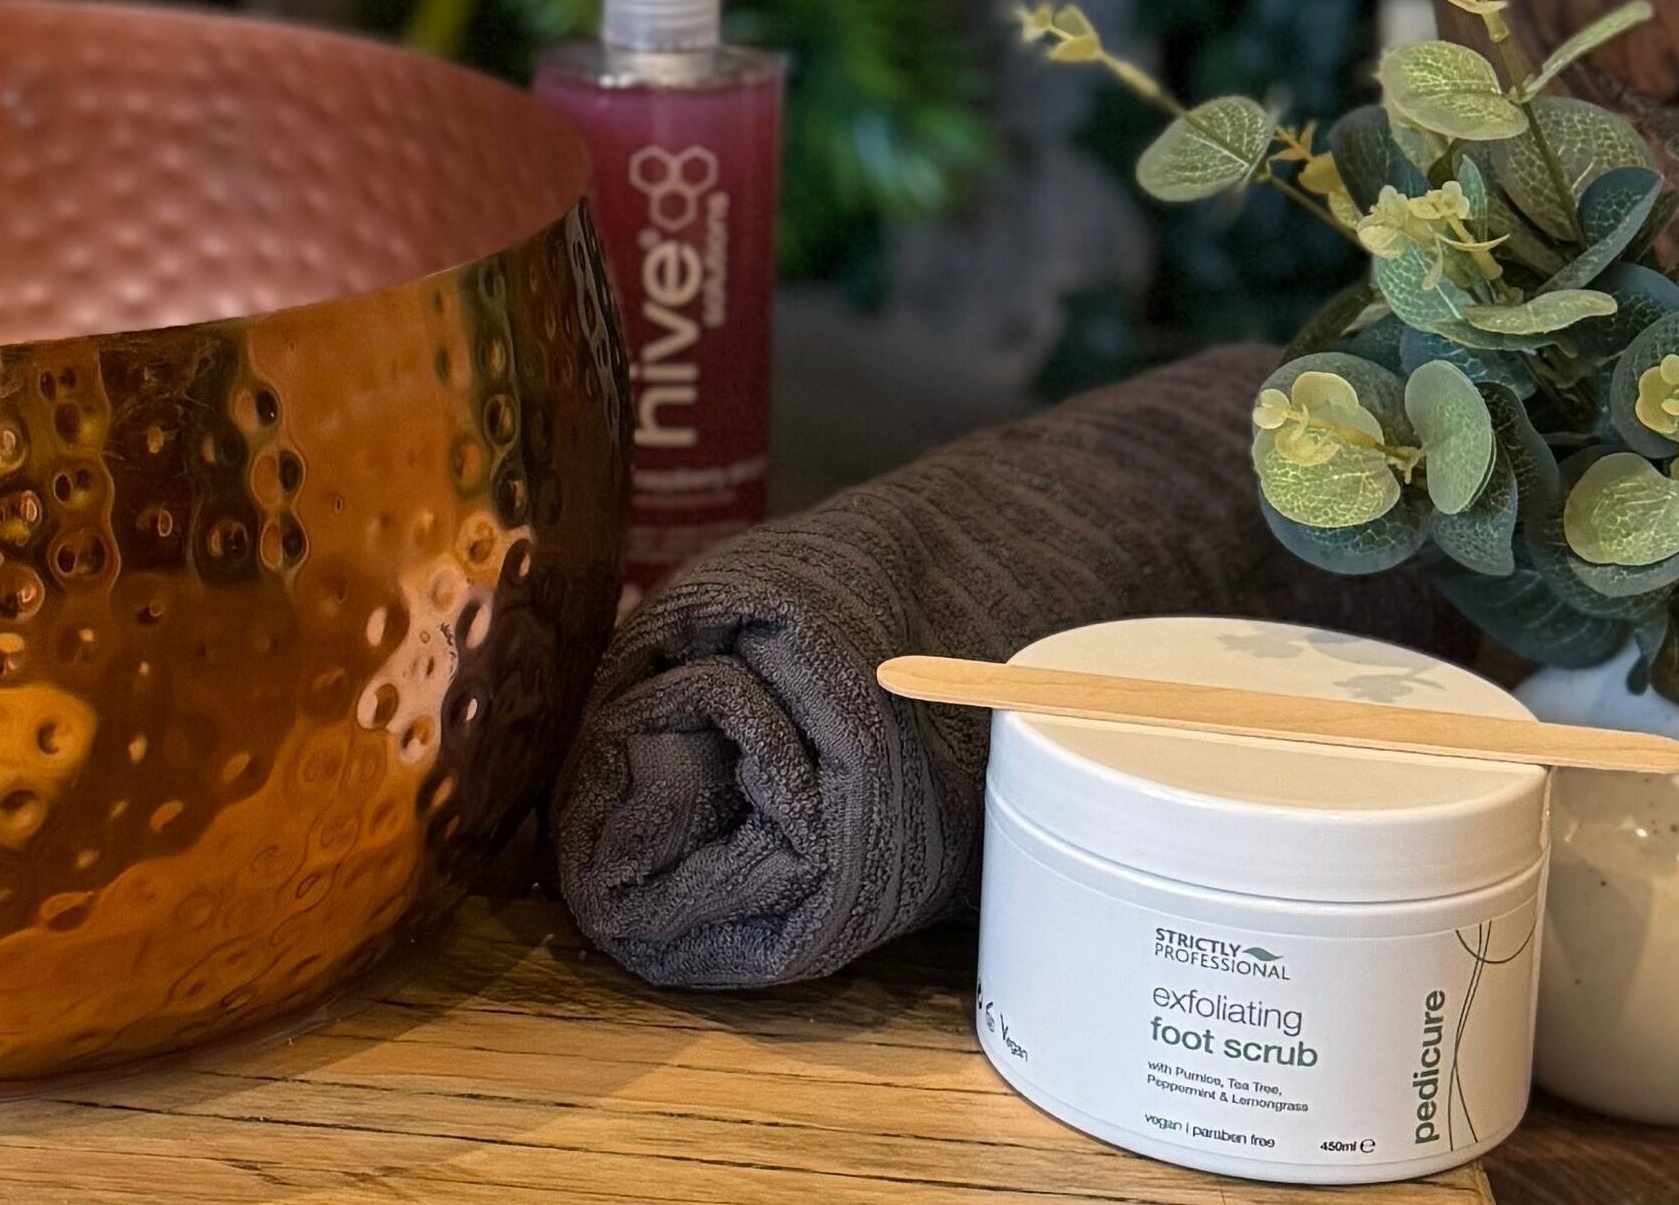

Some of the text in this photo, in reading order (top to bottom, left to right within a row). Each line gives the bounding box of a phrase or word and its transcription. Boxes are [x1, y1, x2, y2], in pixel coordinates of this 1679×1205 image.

[1155, 927, 1241, 958] STRICTLY
[1155, 942, 1291, 980] PROFESSIONAL
[1153, 987, 1302, 1037] exfoliating
[1150, 1016, 1318, 1068] foot scrub
[1147, 1060, 1172, 1076] with
[1228, 1078, 1250, 1091] Tea
[1412, 990, 1446, 1144] pedicure
[1147, 1074, 1216, 1101] Peppermint
[1232, 1095, 1309, 1113] Lemongrass
[1320, 1140, 1357, 1153] 450ml
